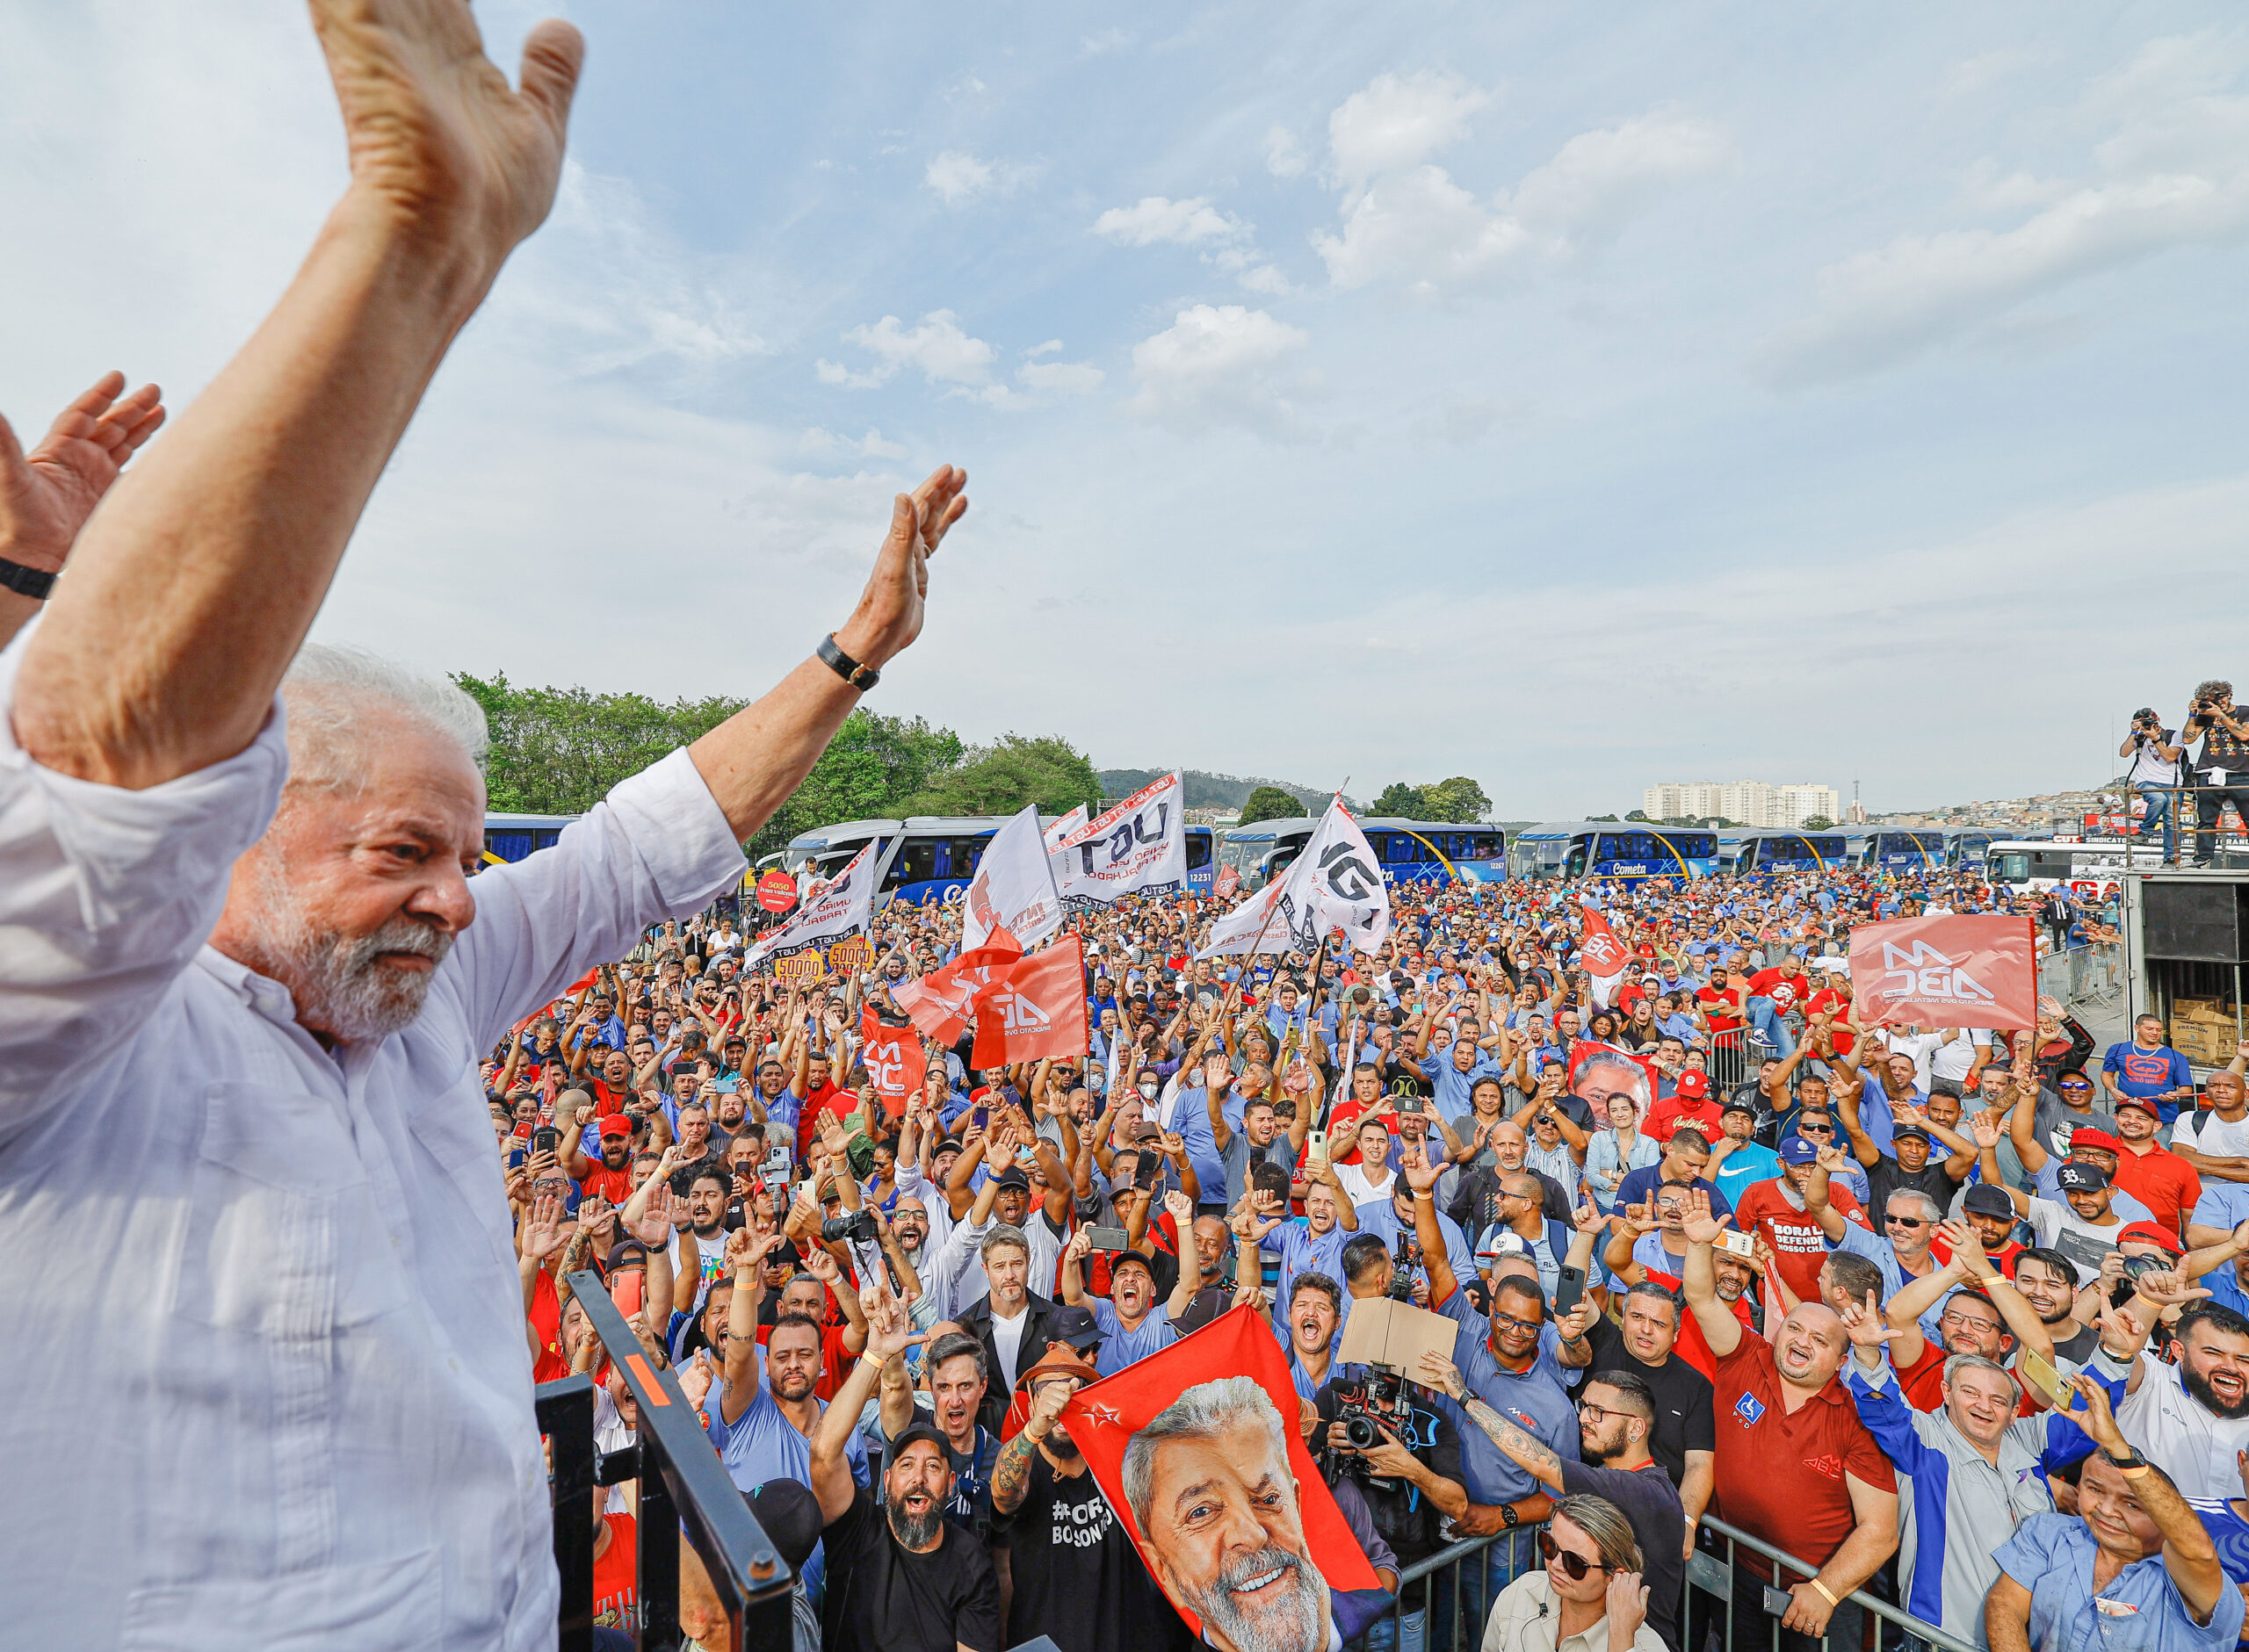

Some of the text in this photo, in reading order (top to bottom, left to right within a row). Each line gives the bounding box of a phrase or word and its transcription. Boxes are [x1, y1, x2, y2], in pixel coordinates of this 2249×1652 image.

[1613, 862, 1646, 876] Cometa
[1190, 873, 1211, 882] 12231
[768, 881, 790, 891] 5050
[833, 949, 871, 963] 50000
[779, 959, 820, 977] 50000
[2177, 1025, 2209, 1035] PREMIUM
[2179, 1044, 2207, 1053] PREMIUM
[1777, 1243, 1805, 1253] NOSSO
